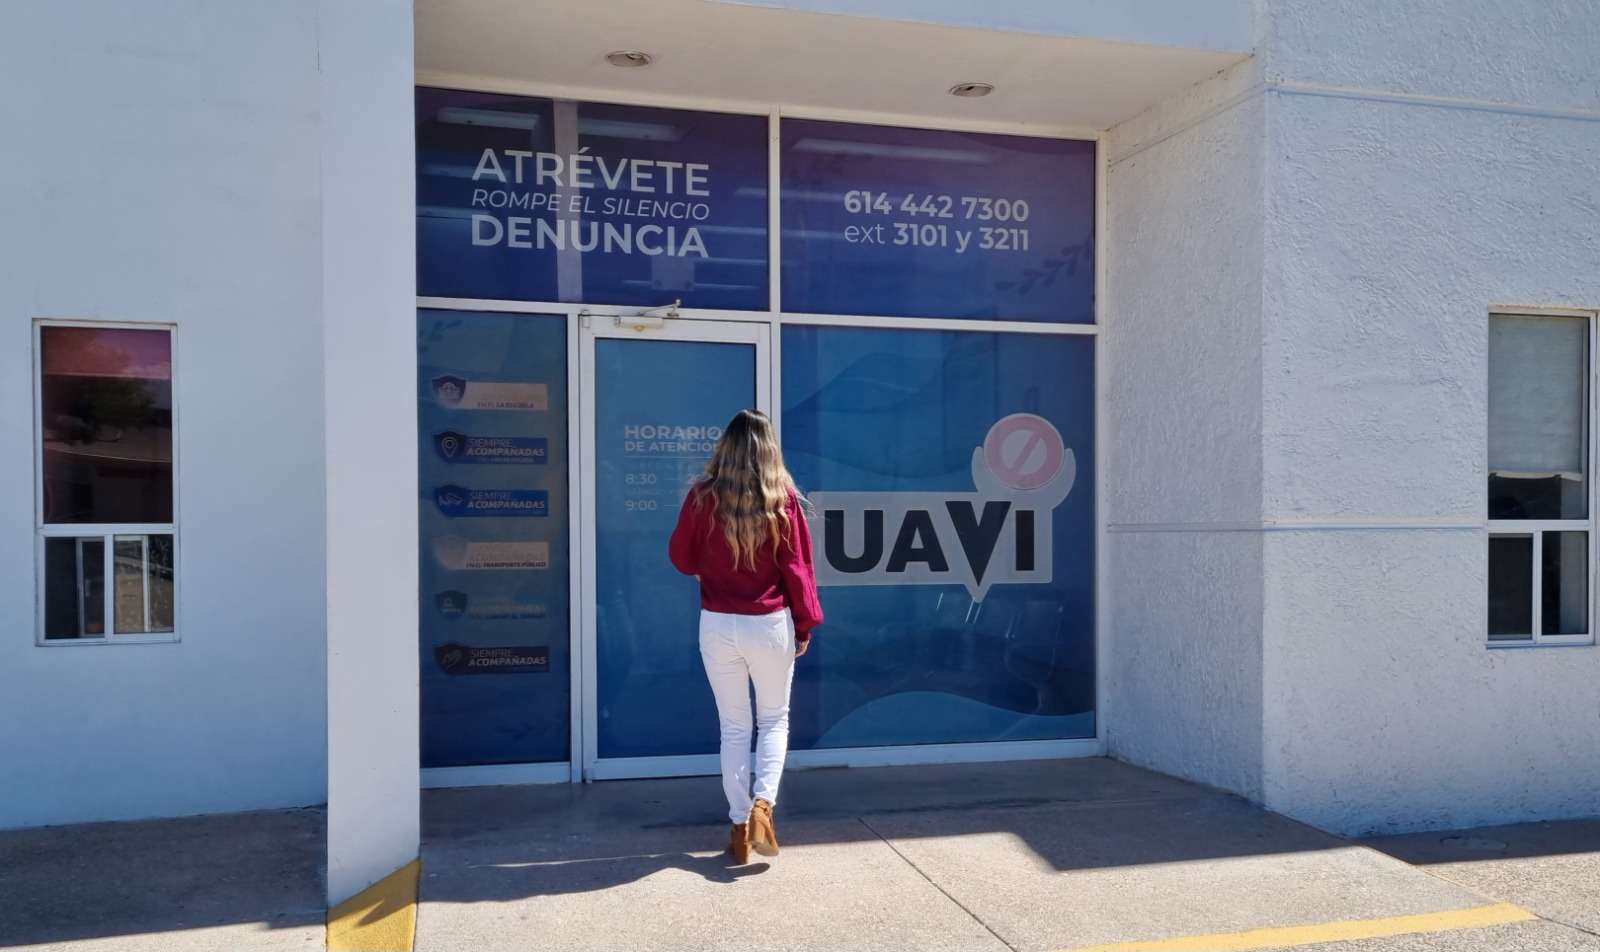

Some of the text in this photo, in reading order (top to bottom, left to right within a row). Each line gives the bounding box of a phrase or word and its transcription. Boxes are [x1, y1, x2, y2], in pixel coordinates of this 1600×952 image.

[472, 147, 710, 197] ATRÉVETE
[472, 189, 710, 221] ROMPE EL SILENCIO
[844, 190, 1029, 222] 614 442 7300
[472, 214, 709, 259] DENUNCIA
[844, 222, 1029, 253] ext 3101 y 3211
[624, 425, 723, 441] HORARIO
[624, 441, 646, 452] DE
[625, 473, 657, 485] 8:30
[625, 500, 657, 512] 9:00
[824, 501, 1035, 588] UAVI
